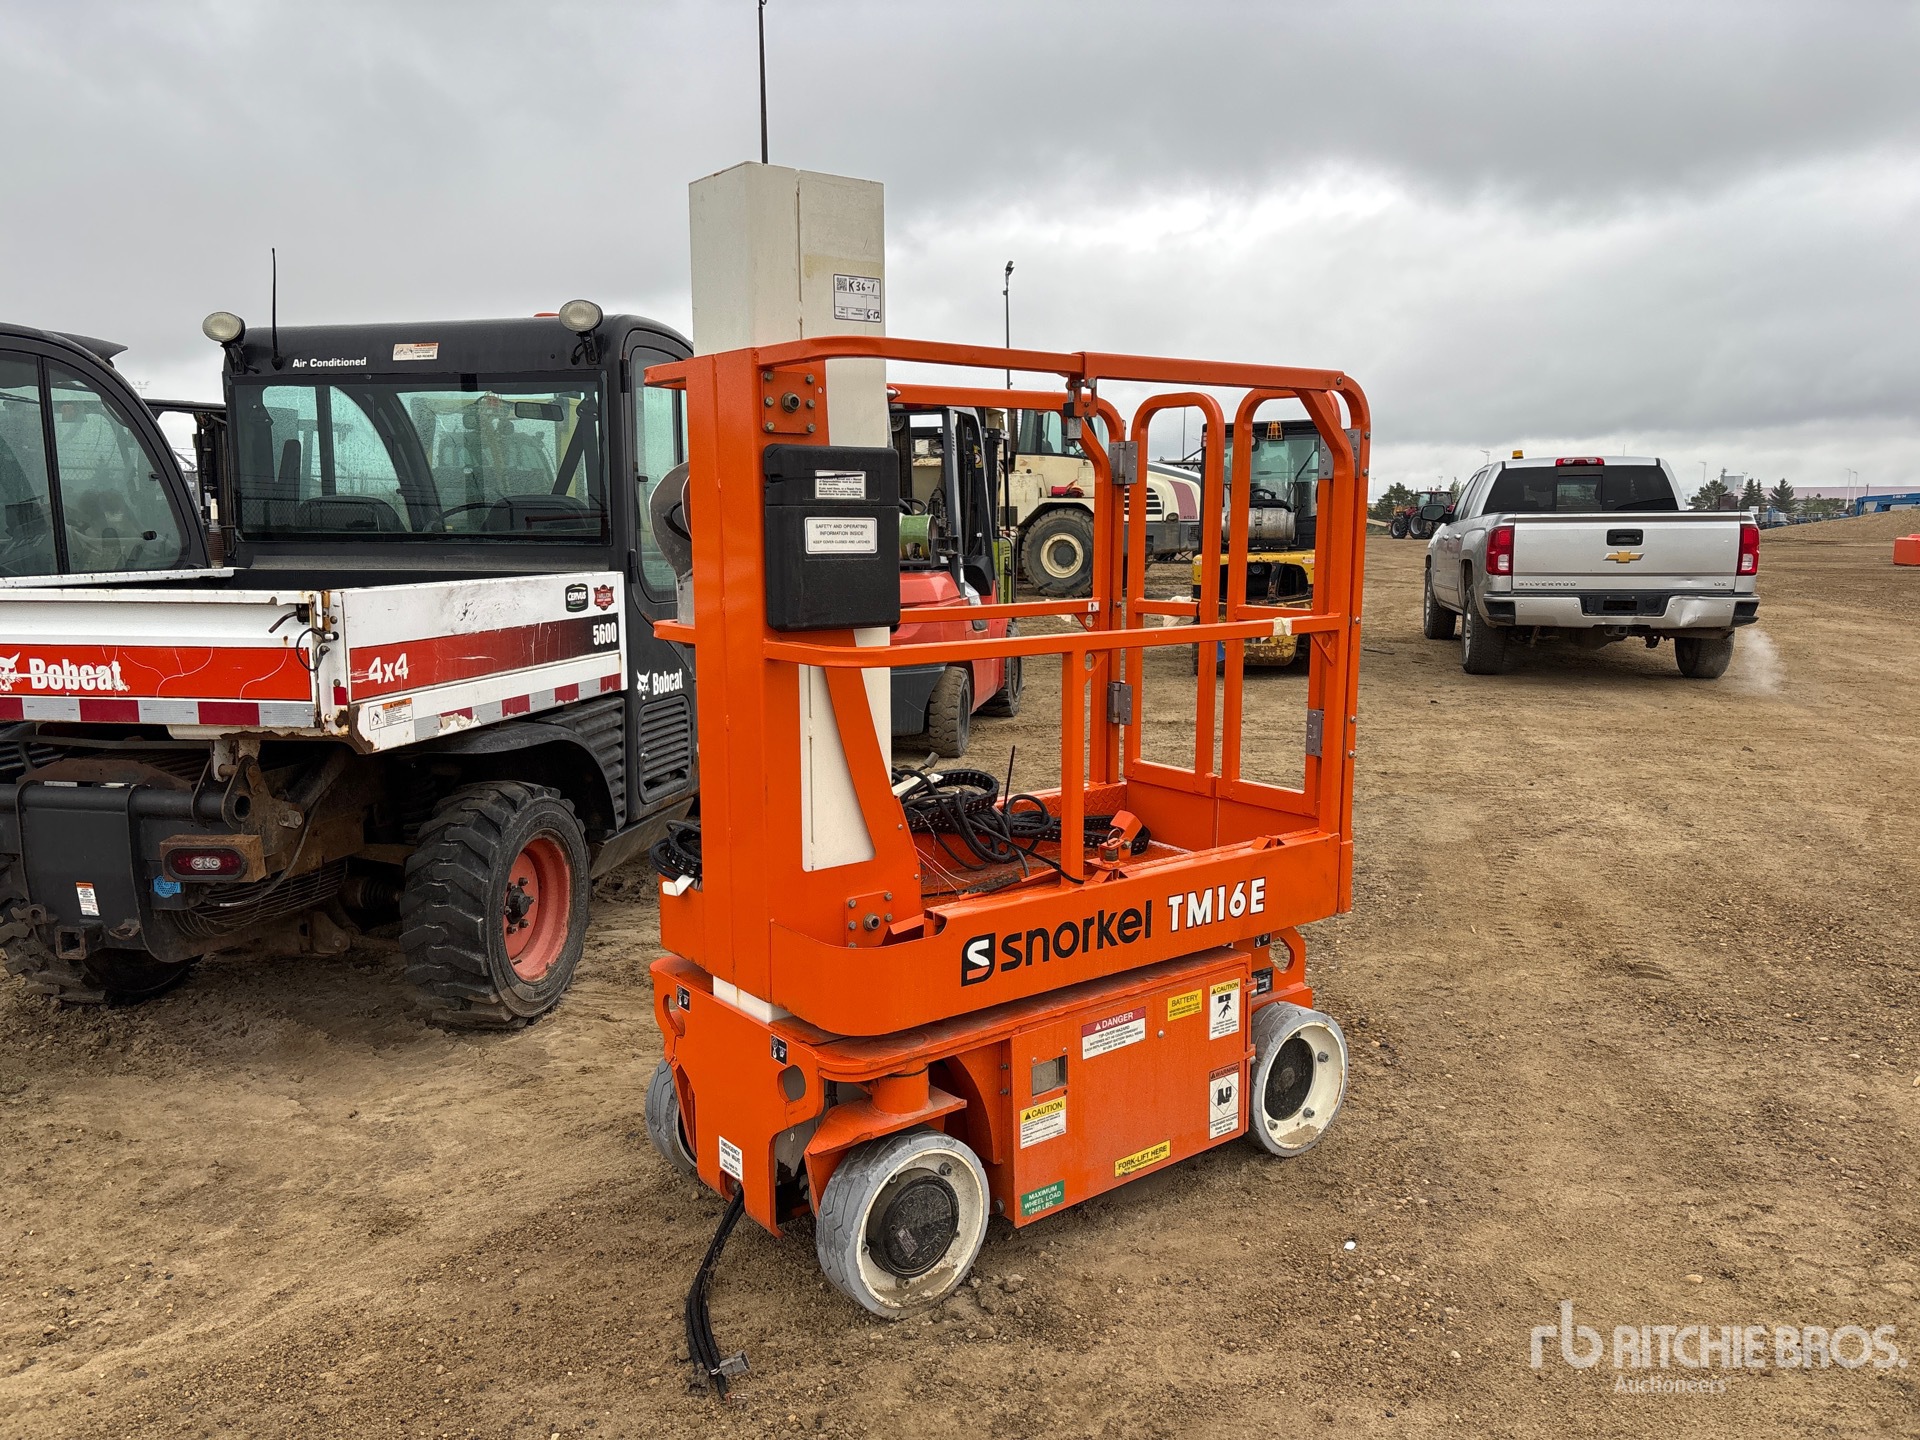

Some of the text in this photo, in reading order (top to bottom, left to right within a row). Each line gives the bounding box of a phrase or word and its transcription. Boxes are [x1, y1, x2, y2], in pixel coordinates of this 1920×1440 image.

[292, 356, 367, 368] Air Conditioned
[567, 591, 586, 602] CERVUS
[592, 622, 617, 646] 5600
[28, 658, 123, 691] Bobcat
[368, 652, 409, 685] 4x4
[652, 668, 684, 696] Bobcat
[1000, 899, 1152, 973] snorkel
[1167, 876, 1267, 933] TM16E
[1216, 982, 1239, 993] CAUTION
[1171, 994, 1198, 1008] BATTERY
[1102, 1012, 1134, 1029] DANGER
[1216, 1064, 1239, 1076] WARNING
[1032, 1101, 1062, 1118] CAUTION
[1118, 1145, 1168, 1170] FORK-LIFT HERE
[1024, 1191, 1062, 1209] WHEEL LOAD
[1028, 1185, 1058, 1200] MAXIMUM
